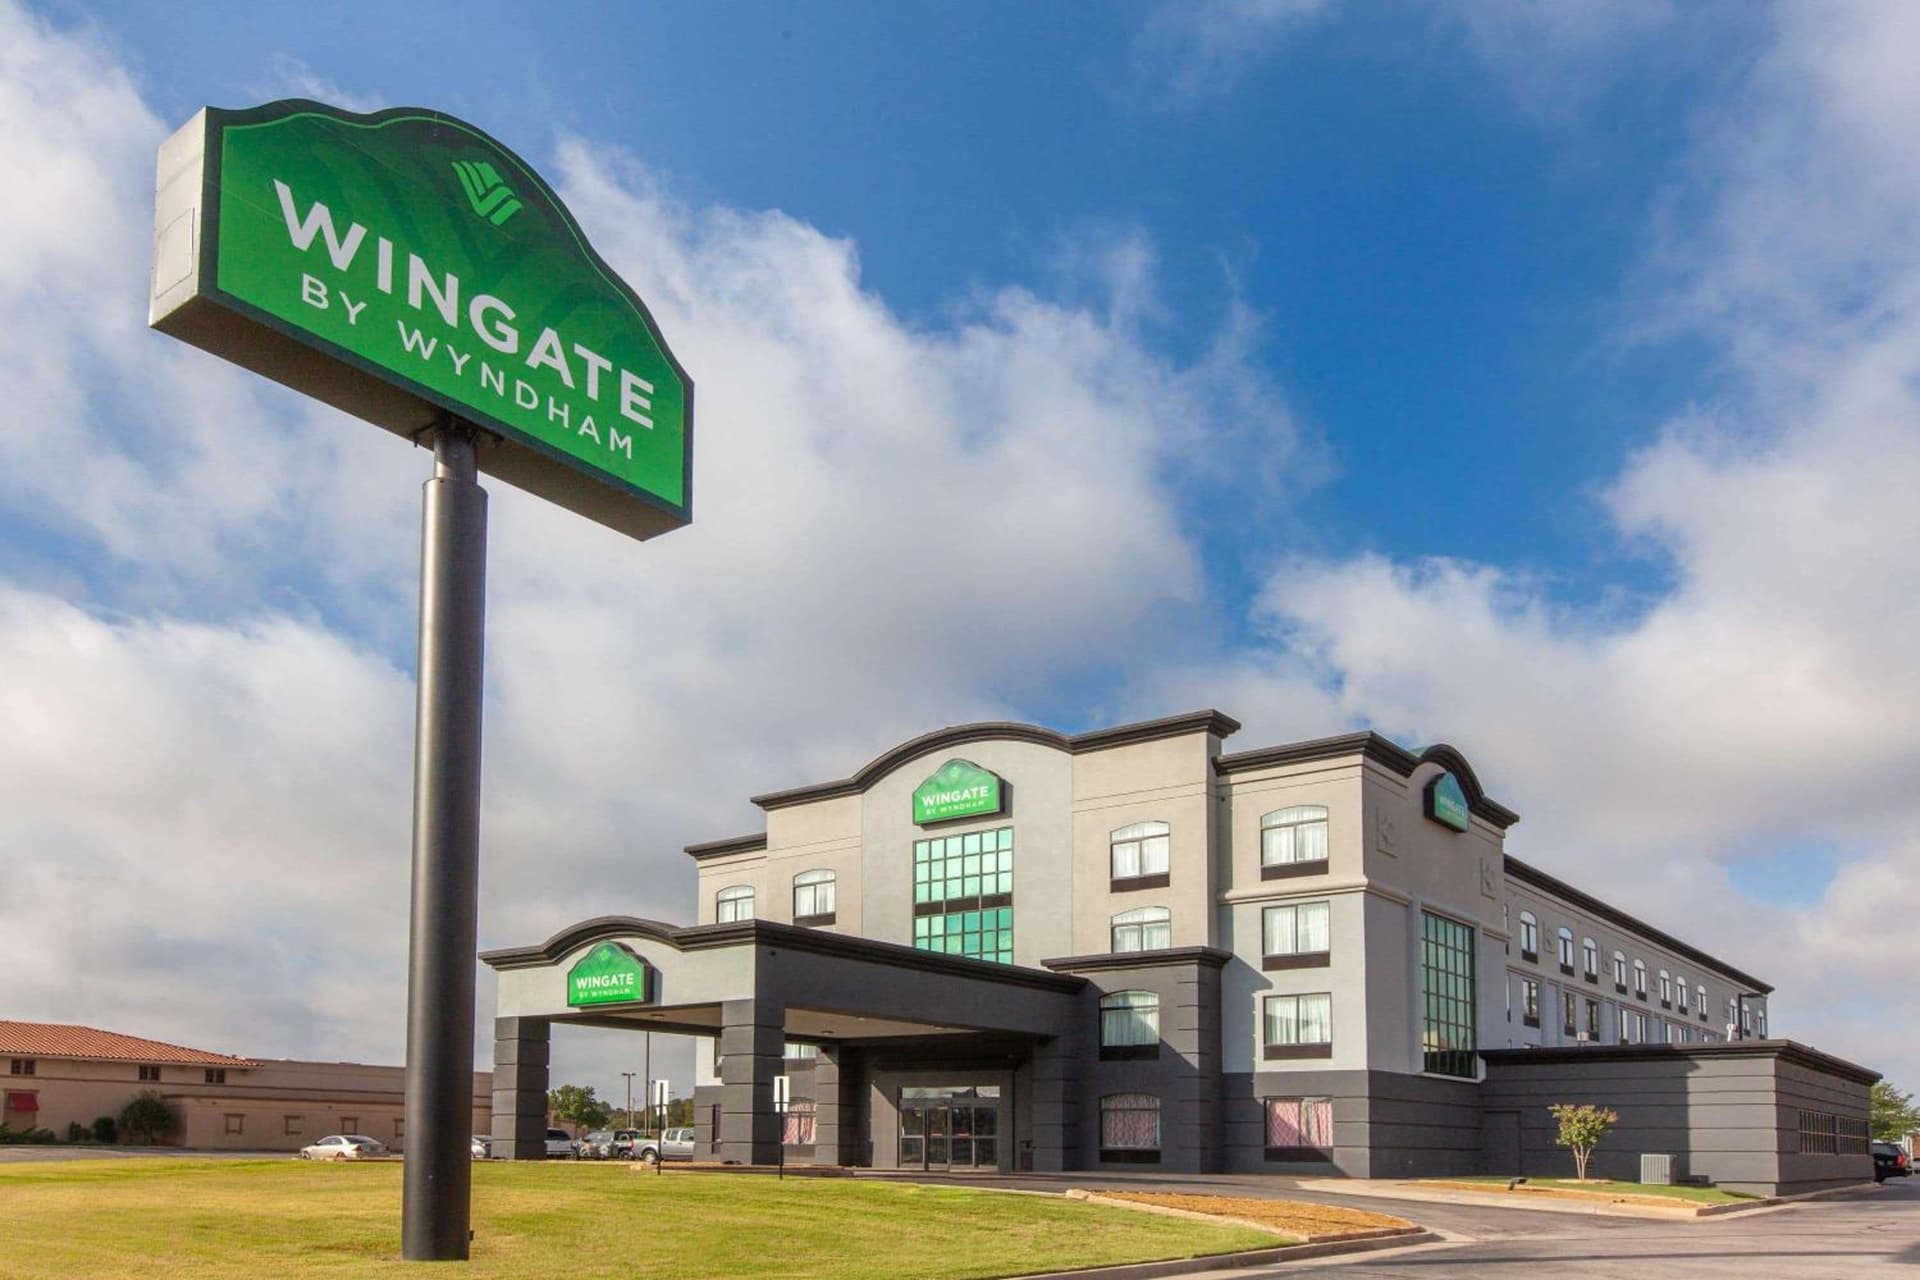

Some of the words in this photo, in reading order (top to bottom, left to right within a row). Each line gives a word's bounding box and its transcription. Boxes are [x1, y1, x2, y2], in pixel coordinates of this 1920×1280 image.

[273, 179, 654, 430] WINGATE
[301, 273, 367, 325] BY
[397, 320, 632, 459] WYNDHAM
[922, 786, 988, 807] WINGATE
[577, 972, 634, 990] WINGATE
